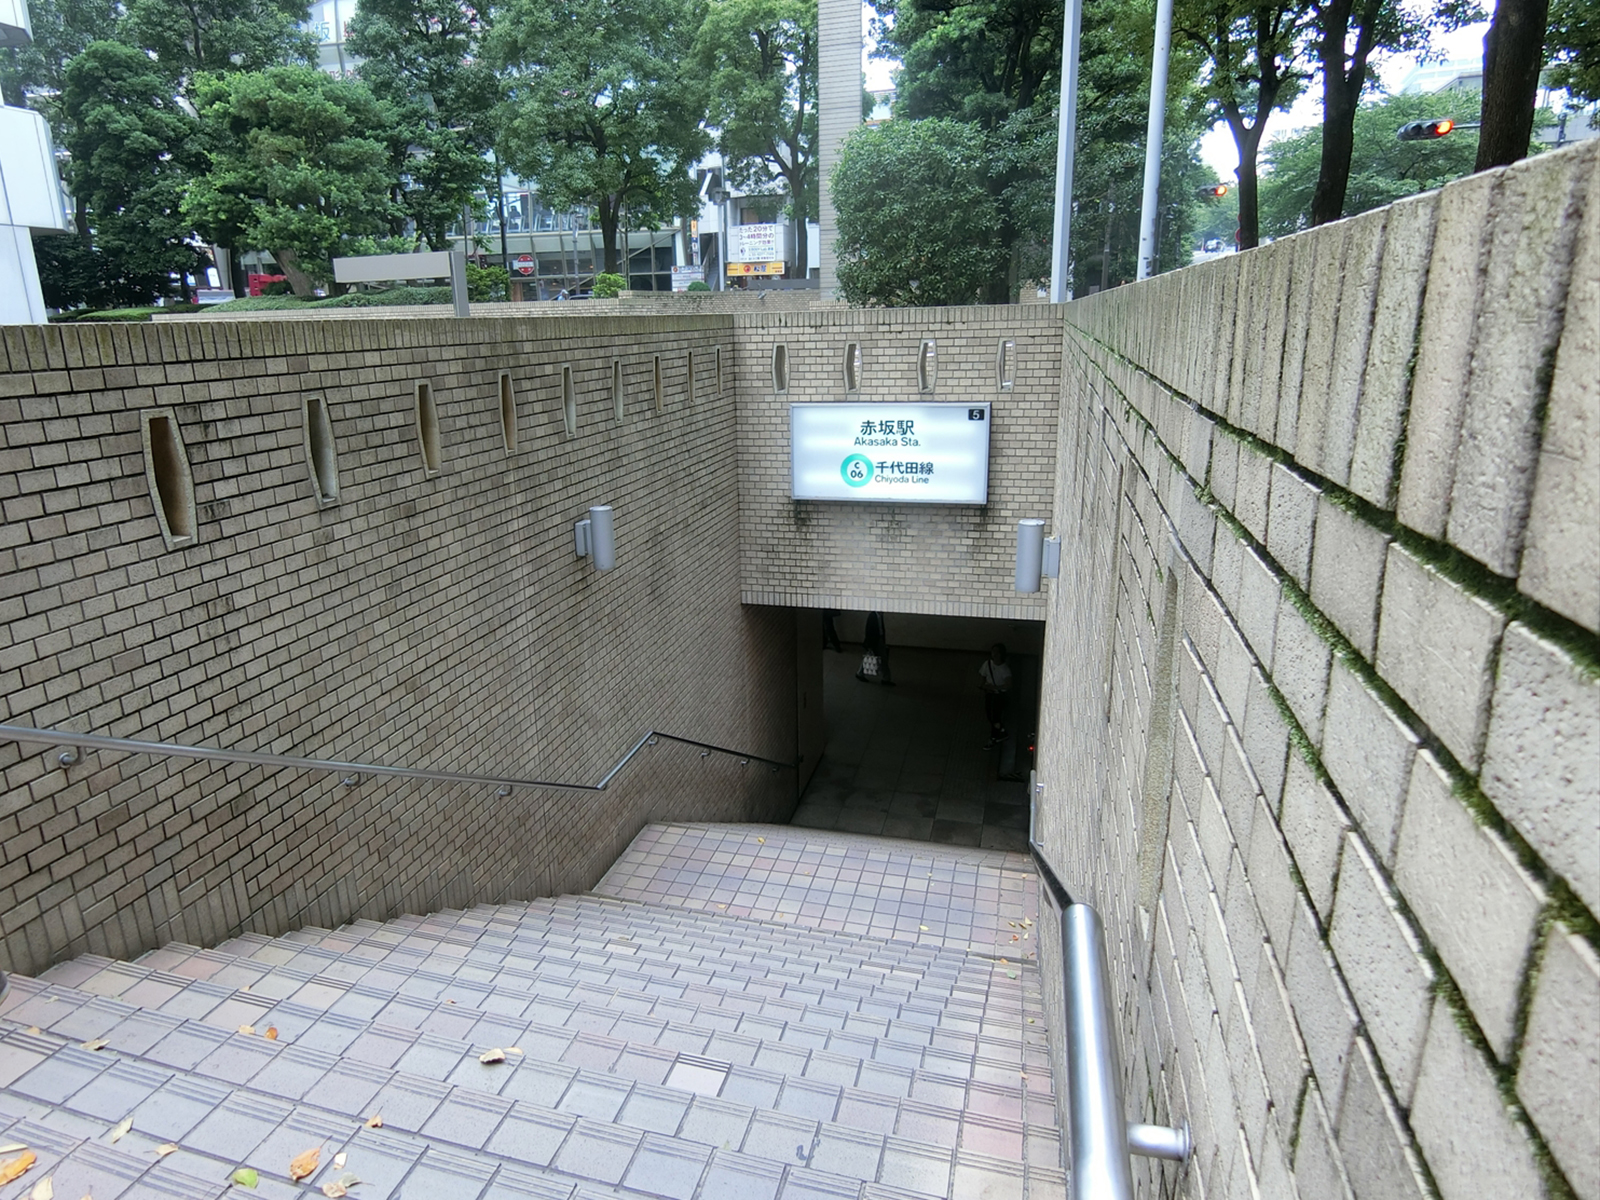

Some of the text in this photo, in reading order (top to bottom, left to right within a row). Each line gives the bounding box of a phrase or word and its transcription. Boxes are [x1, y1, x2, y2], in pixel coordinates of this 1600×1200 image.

[972, 410, 980, 420] 5
[860, 420, 915, 436] 赤坂駅
[854, 437, 921, 446] Akasaka Sta.
[854, 462, 860, 470] C
[875, 462, 934, 475] 千代田線
[850, 470, 864, 479] 06
[875, 475, 930, 484] Chiyoda Line
